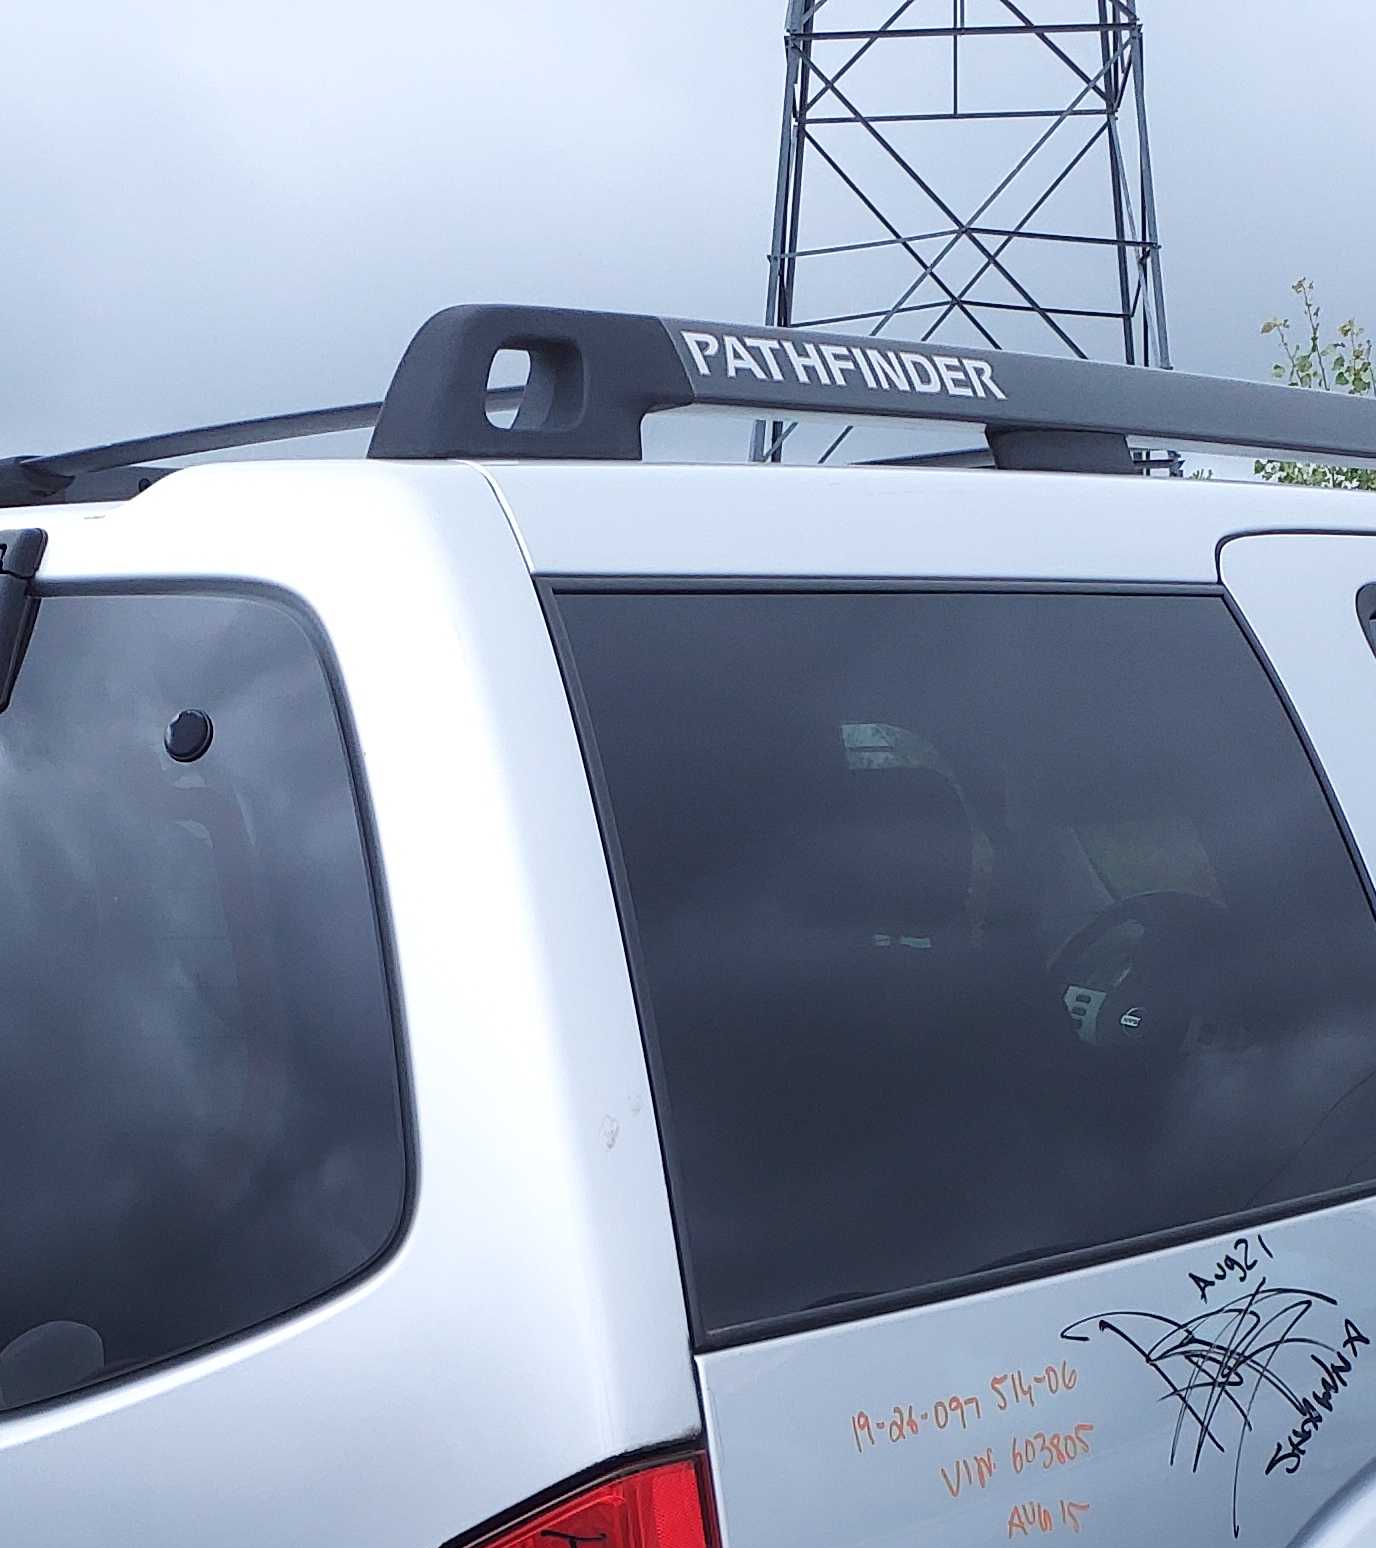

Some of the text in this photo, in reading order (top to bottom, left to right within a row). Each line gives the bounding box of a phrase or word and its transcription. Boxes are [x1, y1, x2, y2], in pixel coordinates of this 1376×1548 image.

[680, 331, 1008, 400] PATHFINDER
[1012, 1424, 1094, 1474] 603805
[1060, 1500, 1091, 1533] 15
